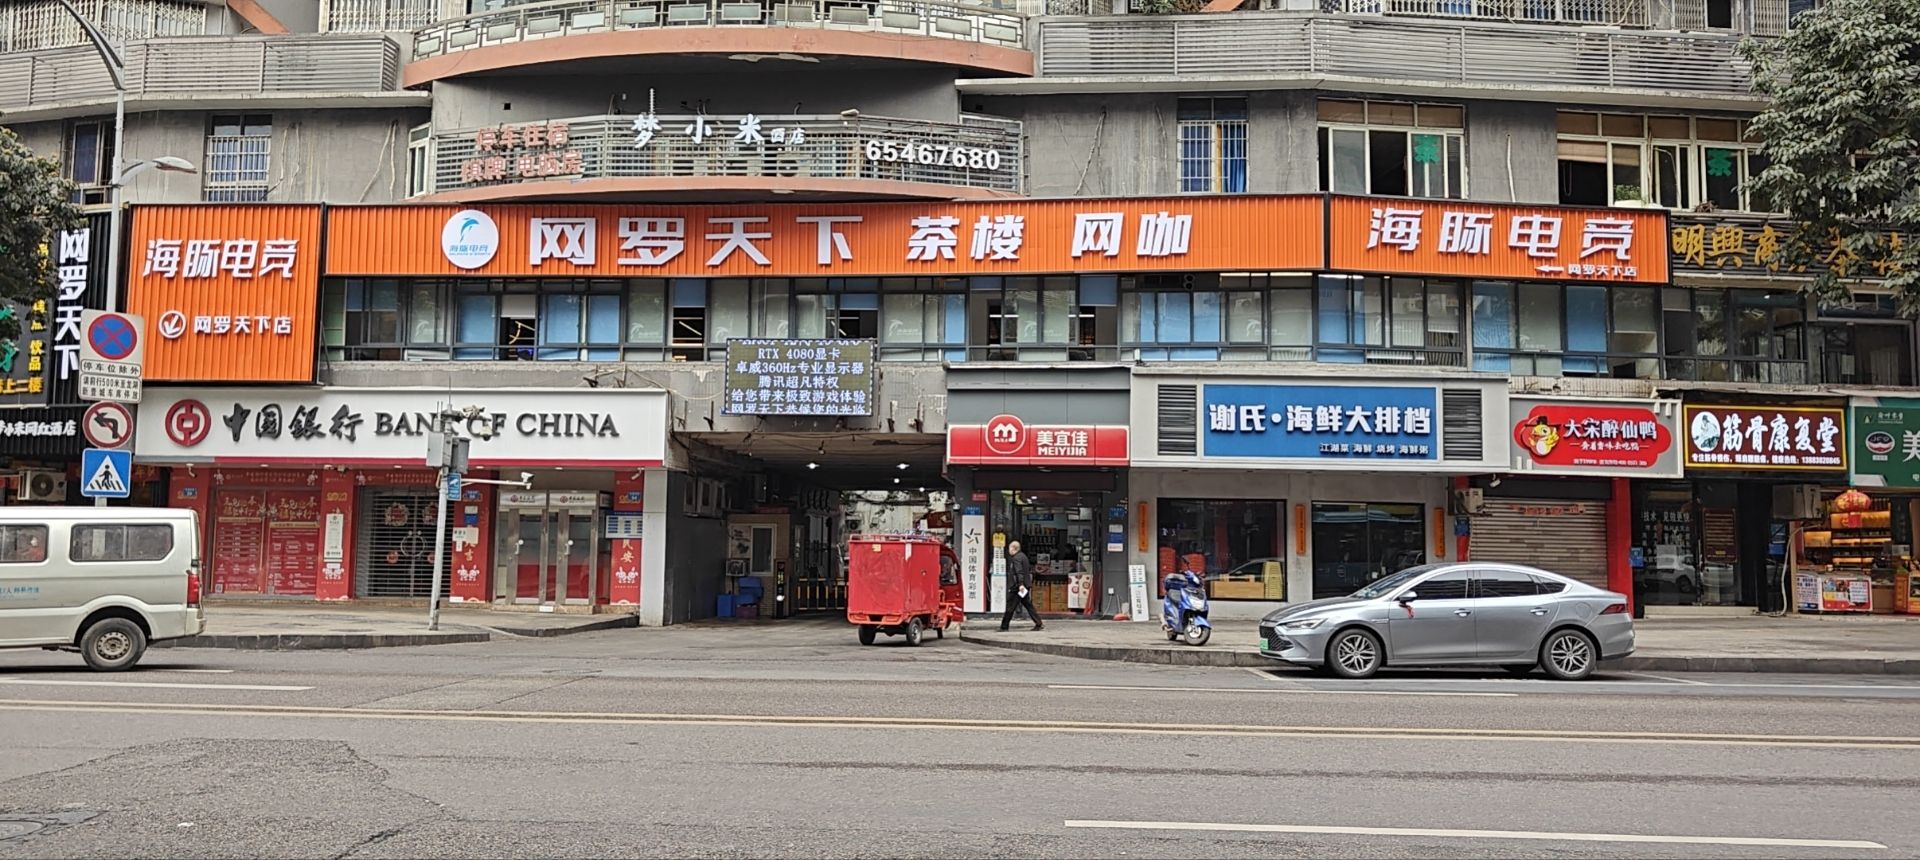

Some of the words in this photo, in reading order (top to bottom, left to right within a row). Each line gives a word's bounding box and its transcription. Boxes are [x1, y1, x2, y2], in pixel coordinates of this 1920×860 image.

[866, 140, 1001, 170] 65467680
[530, 216, 863, 266] 网罗天下
[906, 214, 1024, 260] 茶楼
[1071, 211, 1193, 258] 网咖
[1366, 207, 1635, 260] 海豚电竞
[143, 238, 299, 278] 海豚电竞
[1568, 263, 1637, 277] 网罗天下店
[54, 228, 90, 380] 网罗天下
[194, 315, 291, 335] 网罗天下店
[758, 348, 779, 359] RTX
[786, 347, 841, 360] 4080显卡
[83, 361, 139, 375] 停车位除外
[735, 360, 864, 375] 卓威360Hz专业显示器
[0, 377, 43, 393] 上二楼
[758, 376, 839, 389] 腾讯超凡特权
[731, 389, 866, 403] 给您带来极致游戏体验
[374, 411, 459, 437] BAN
[516, 412, 619, 437] CHINA
[1563, 418, 1657, 439] 大宋醉仙鸭
[1037, 430, 1088, 447] 美宜佳
[1038, 446, 1087, 457] MEIYIJIA
[1320, 443, 1349, 453] 江湖菜
[1353, 443, 1372, 453] 海鲜
[1376, 444, 1395, 454] 烧烤
[1399, 444, 1429, 455] 海鲜粥
[968, 546, 977, 600] 中国体育彩票
